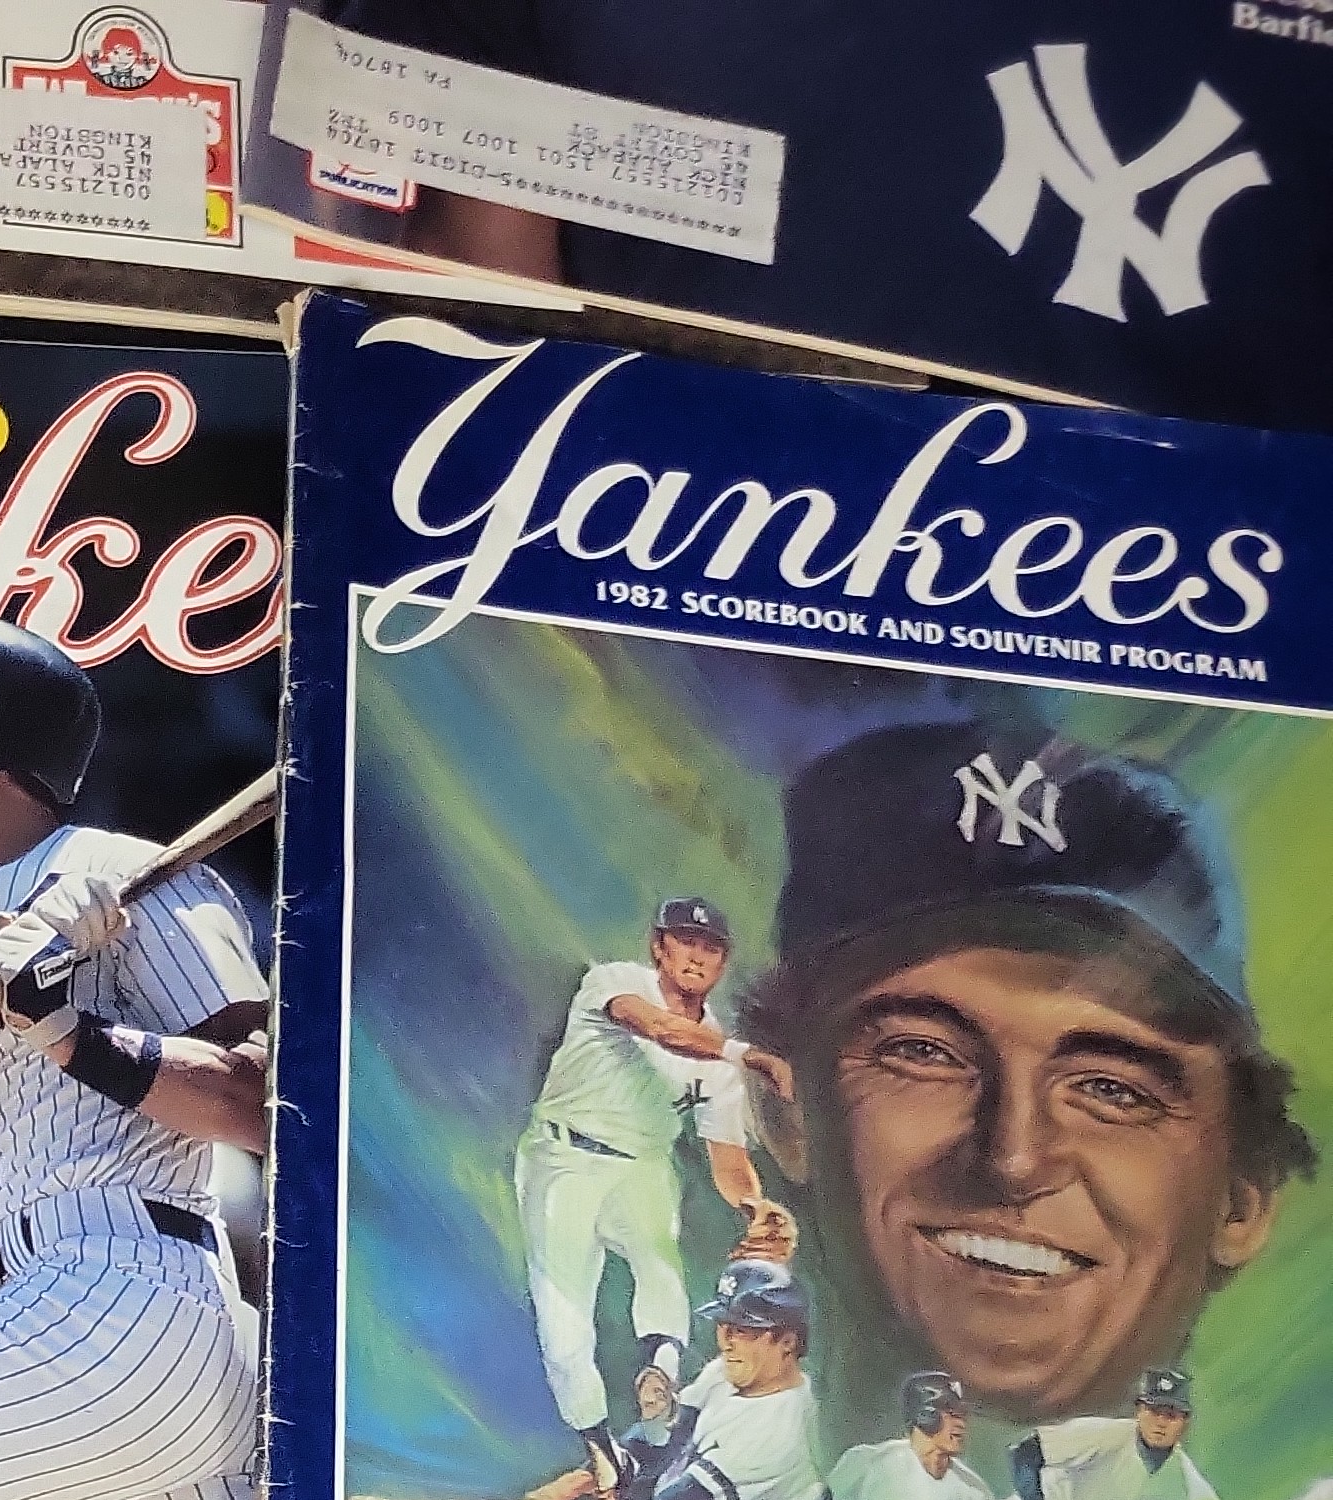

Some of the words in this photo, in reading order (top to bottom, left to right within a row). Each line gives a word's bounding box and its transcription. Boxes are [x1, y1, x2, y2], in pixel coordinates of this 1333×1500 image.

[16, 173, 151, 200] 001215557
[92, 163, 152, 182] NICK
[124, 149, 152, 167] 45
[969, 43, 1272, 324] NY
[355, 314, 1285, 654] Yankees
[594, 579, 671, 612] 1982
[681, 590, 869, 638] SCOREBOOK
[877, 617, 944, 647] AND
[950, 623, 1103, 666] SOUVENIR
[1109, 642, 1266, 684] PROGRAM
[956, 752, 1066, 853] NY
